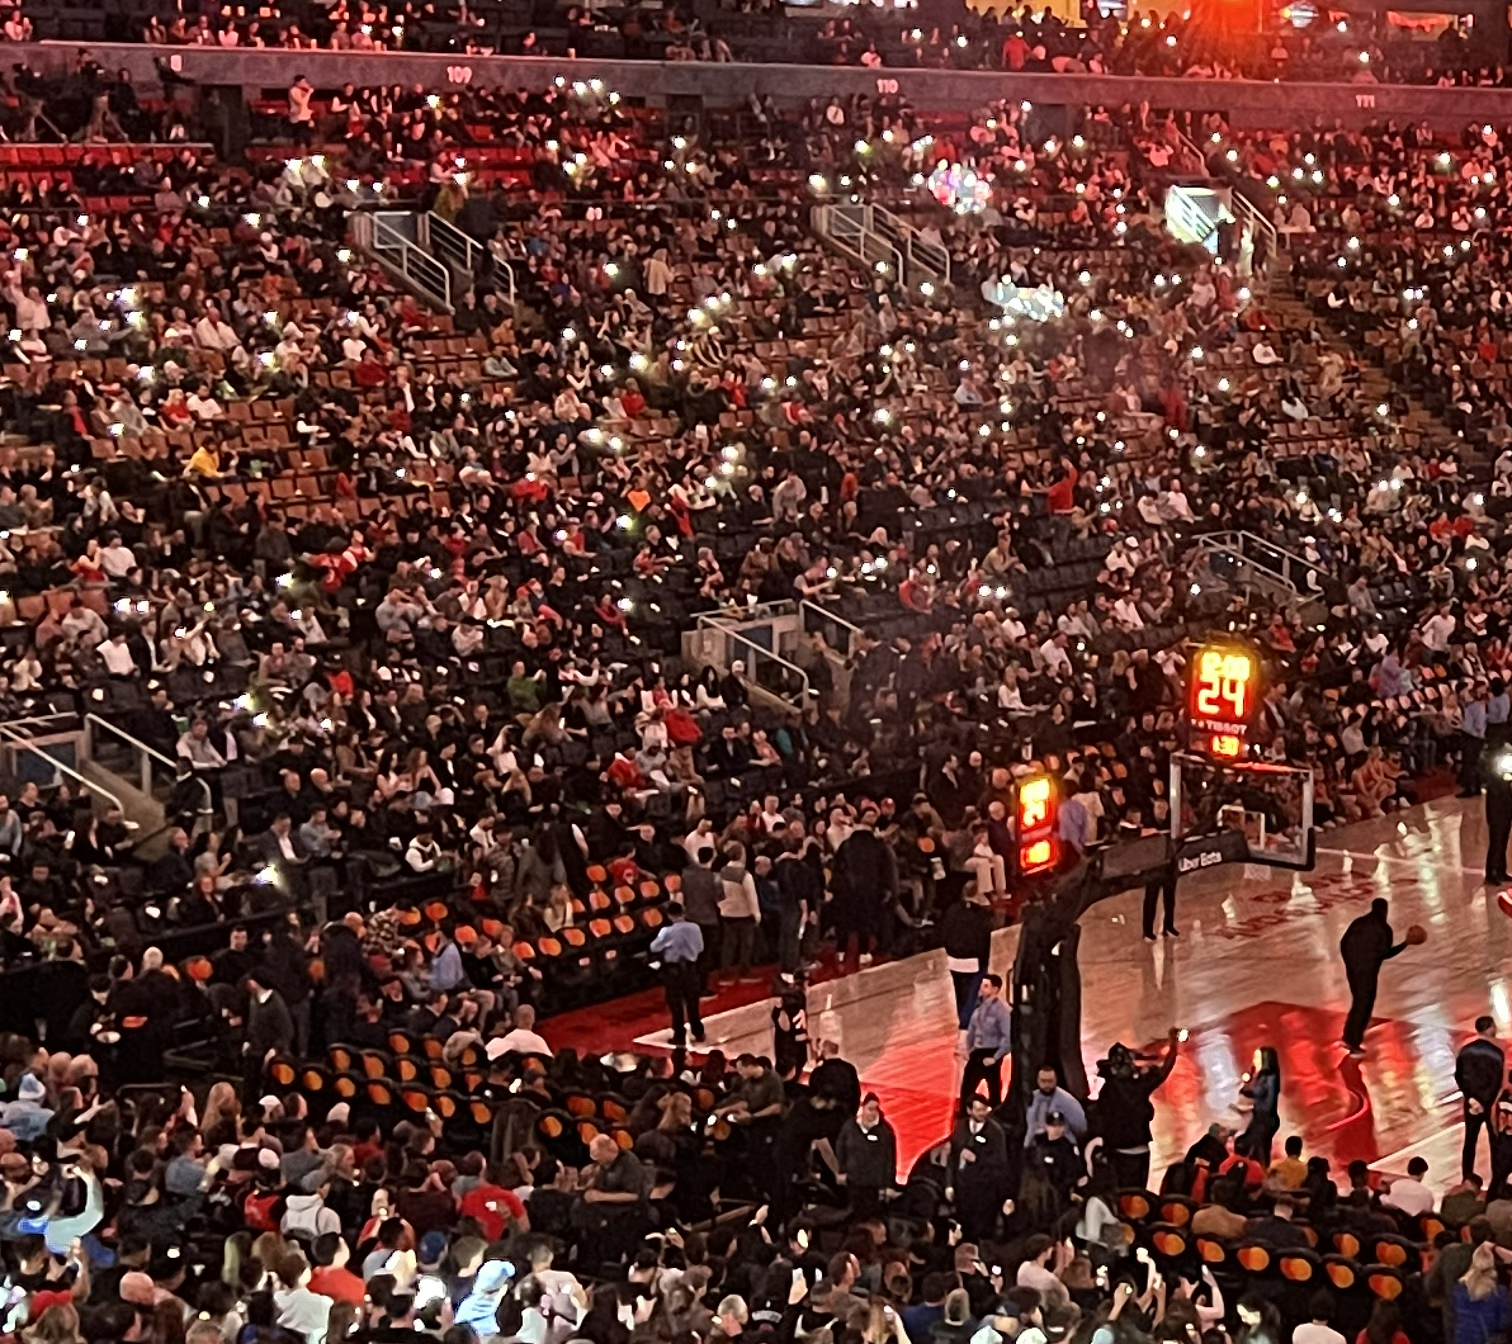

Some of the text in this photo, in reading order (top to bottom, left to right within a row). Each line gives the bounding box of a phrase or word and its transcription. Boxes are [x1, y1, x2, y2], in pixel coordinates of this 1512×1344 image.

[446, 65, 473, 84] 109
[875, 78, 900, 94] 110
[1355, 94, 1376, 109] 111
[1198, 676, 1245, 718] 24
[1206, 719, 1248, 735] TISSOT
[1178, 851, 1222, 872] Uber Eats
